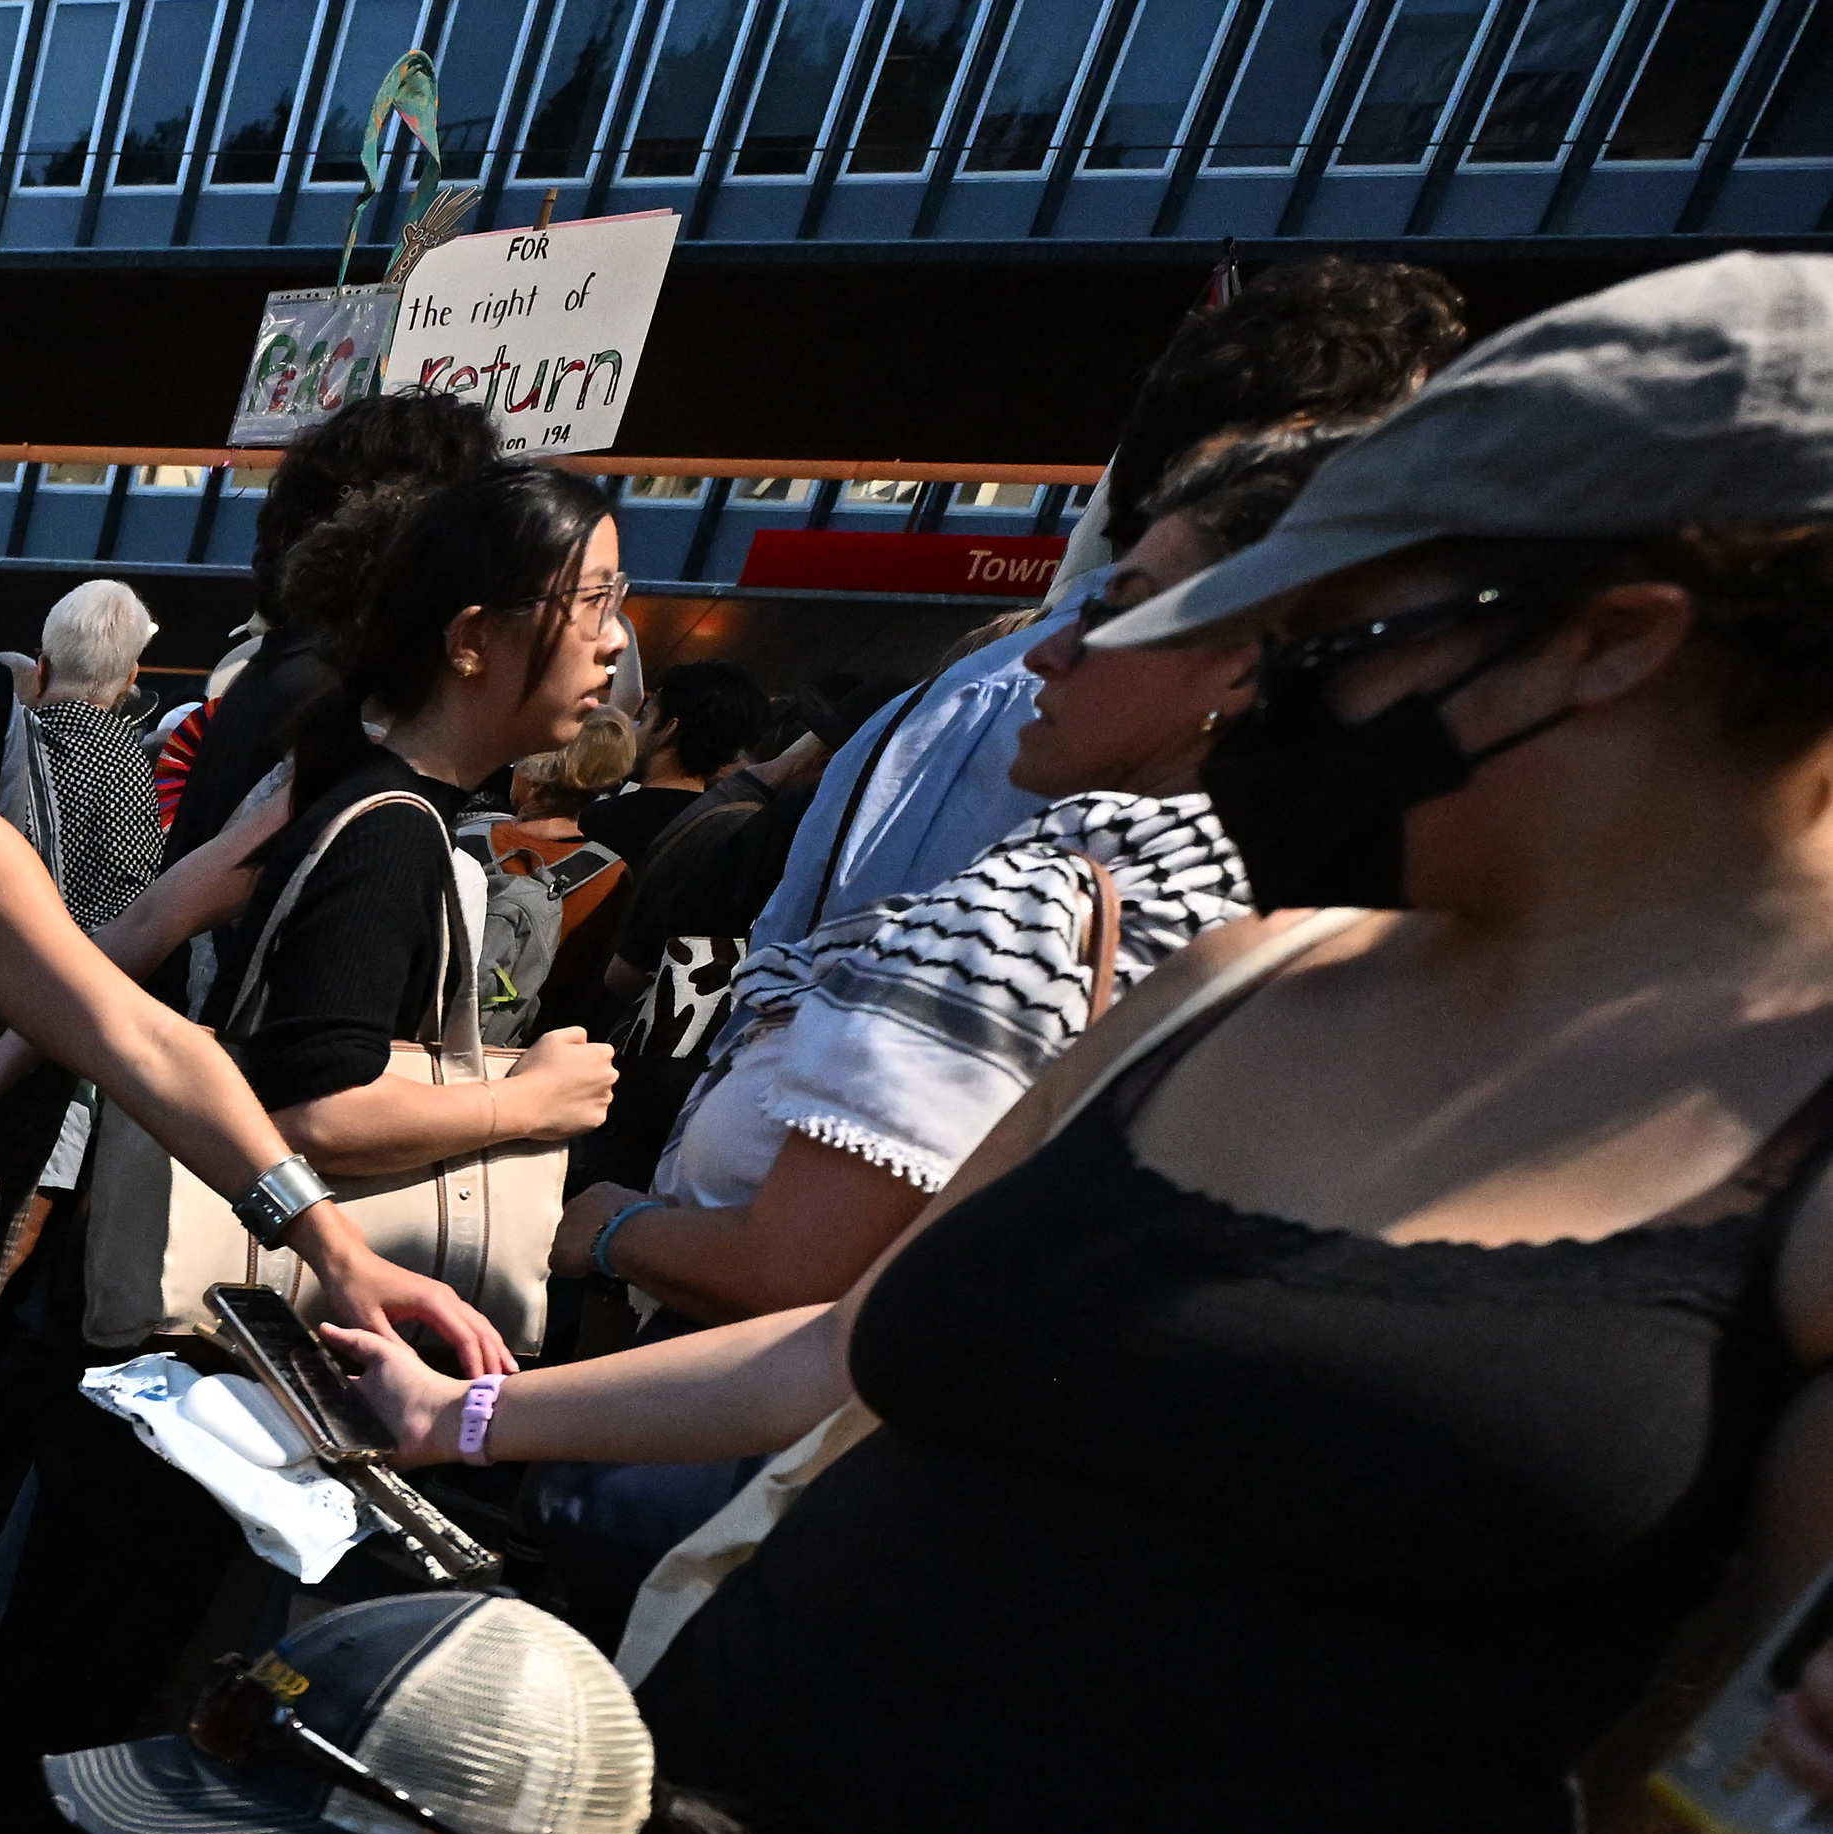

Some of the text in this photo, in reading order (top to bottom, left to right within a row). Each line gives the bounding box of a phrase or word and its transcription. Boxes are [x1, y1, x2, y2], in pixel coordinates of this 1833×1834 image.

[506, 235, 549, 262] FOR
[408, 271, 597, 331] the right of
[247, 334, 371, 414] PEACE
[419, 344, 623, 415] return
[541, 424, 571, 445] 194
[967, 550, 1061, 583] Town
